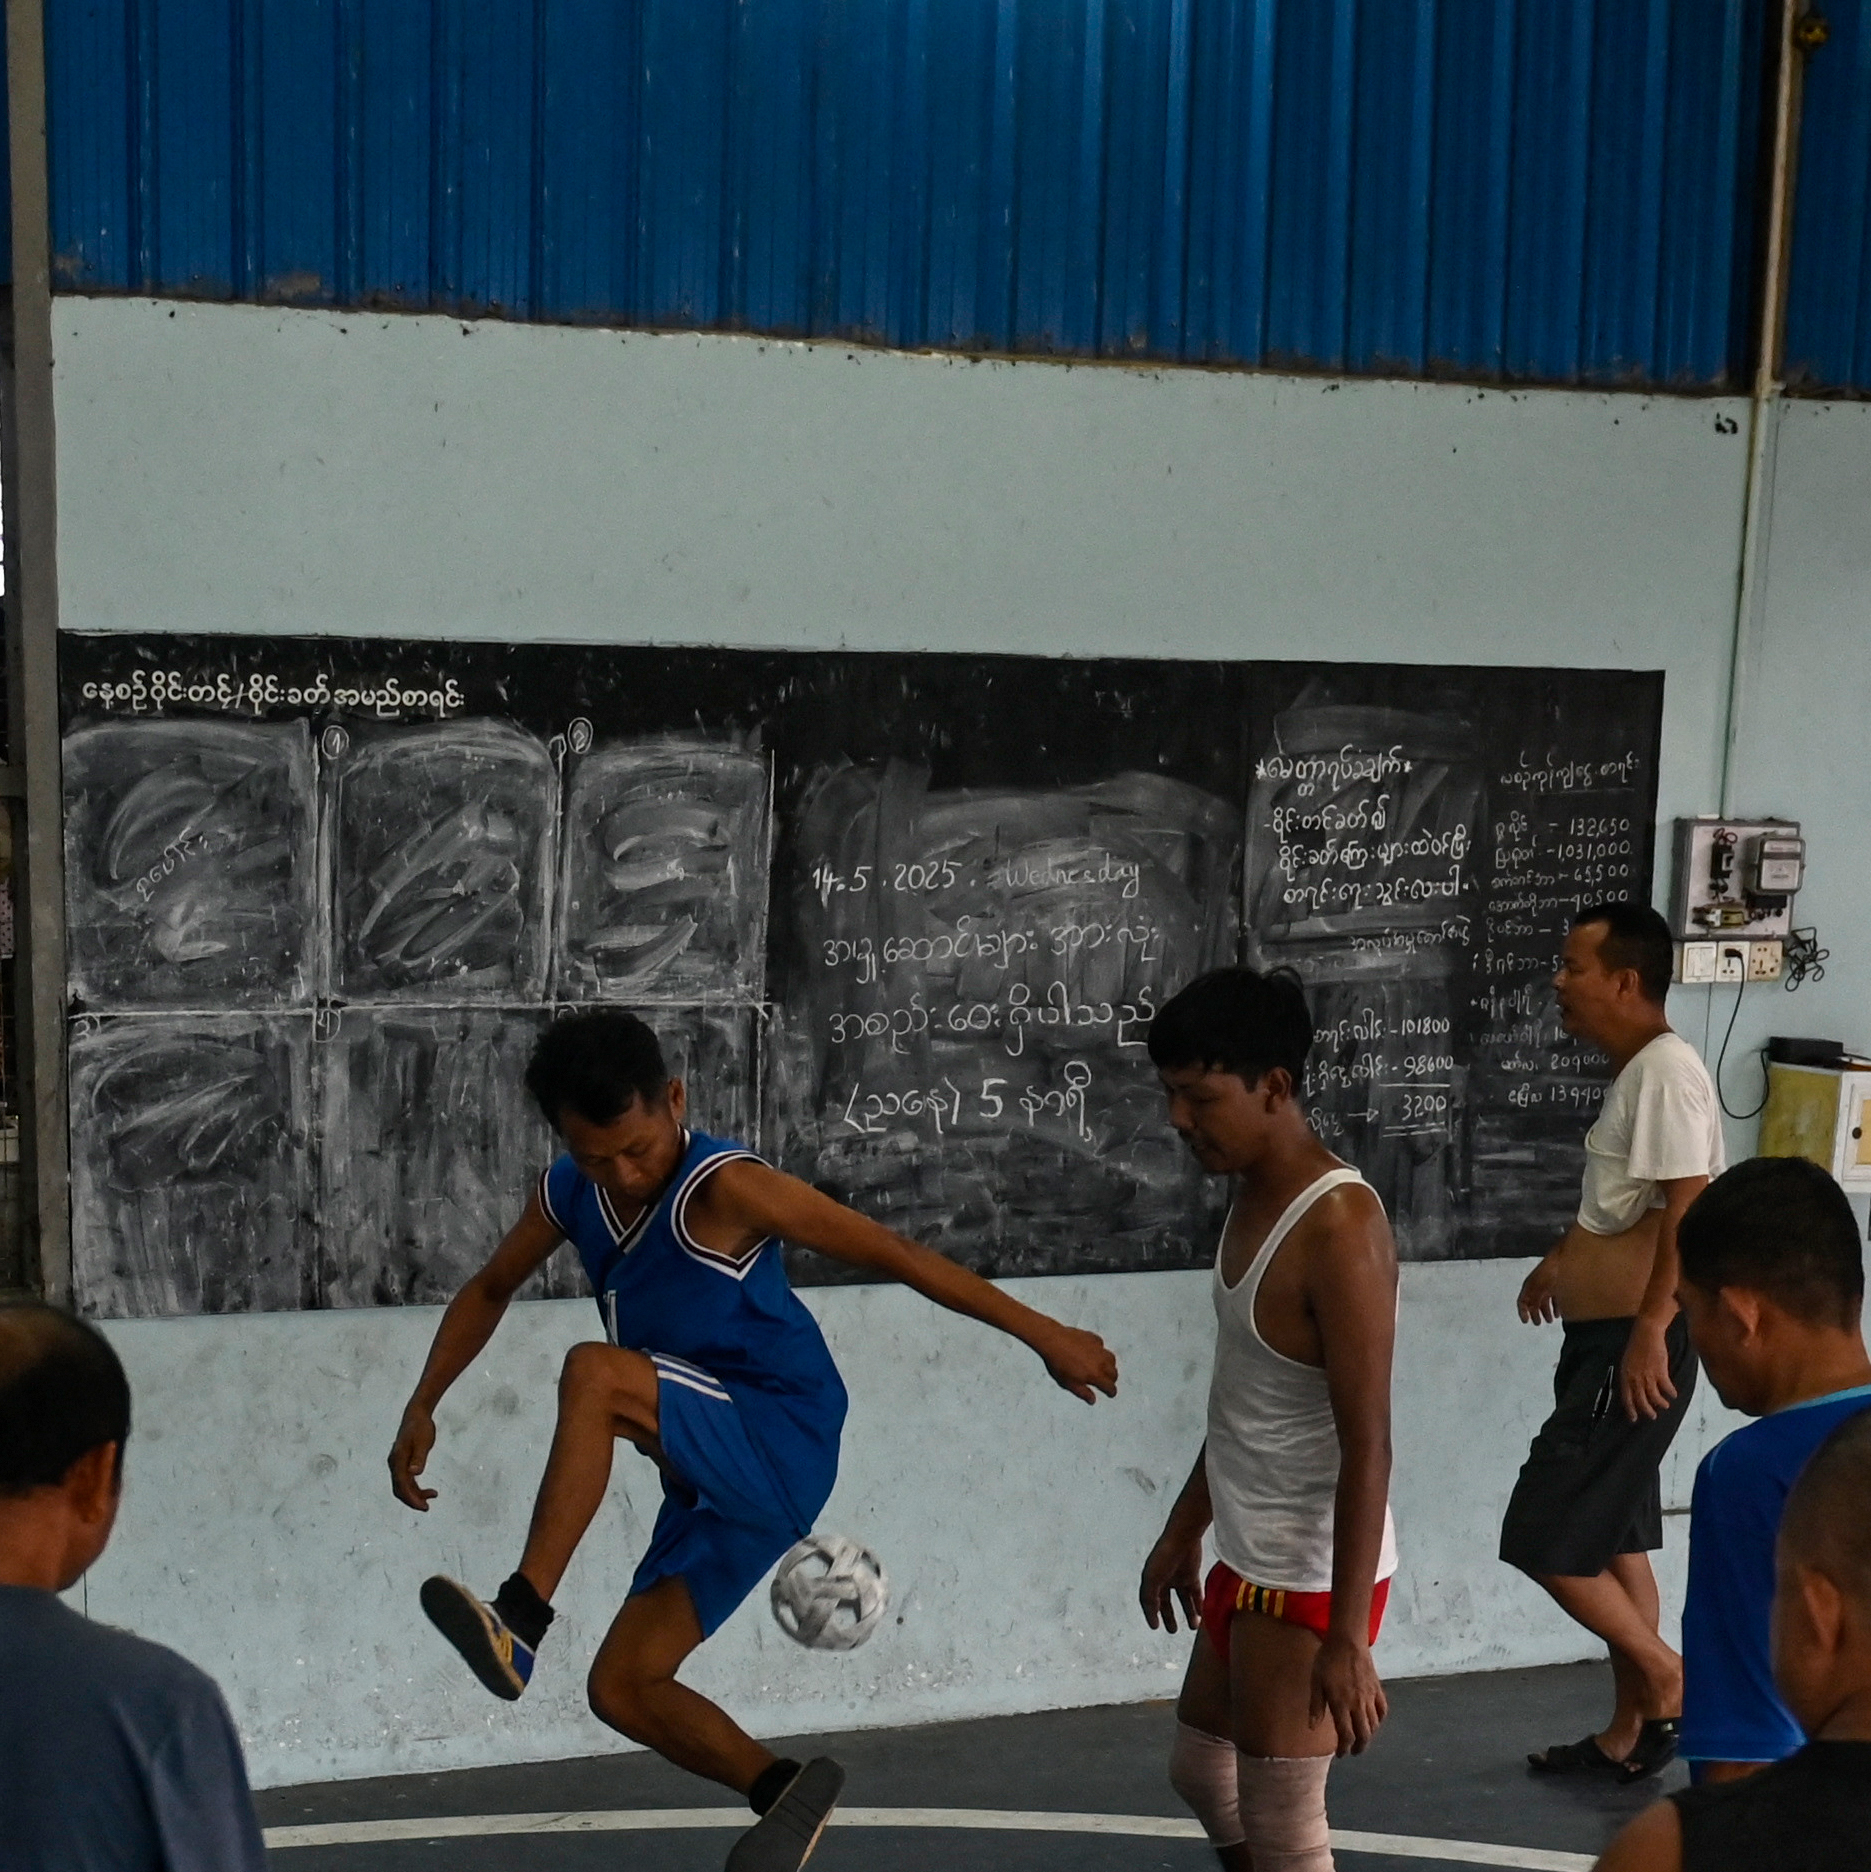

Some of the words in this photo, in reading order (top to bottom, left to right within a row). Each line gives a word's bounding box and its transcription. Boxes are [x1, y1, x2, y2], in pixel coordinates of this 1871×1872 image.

[1006, 852, 1141, 898] Wednesday
[979, 1078, 1008, 1118] 5
[1402, 1093, 1448, 1122] 3200
